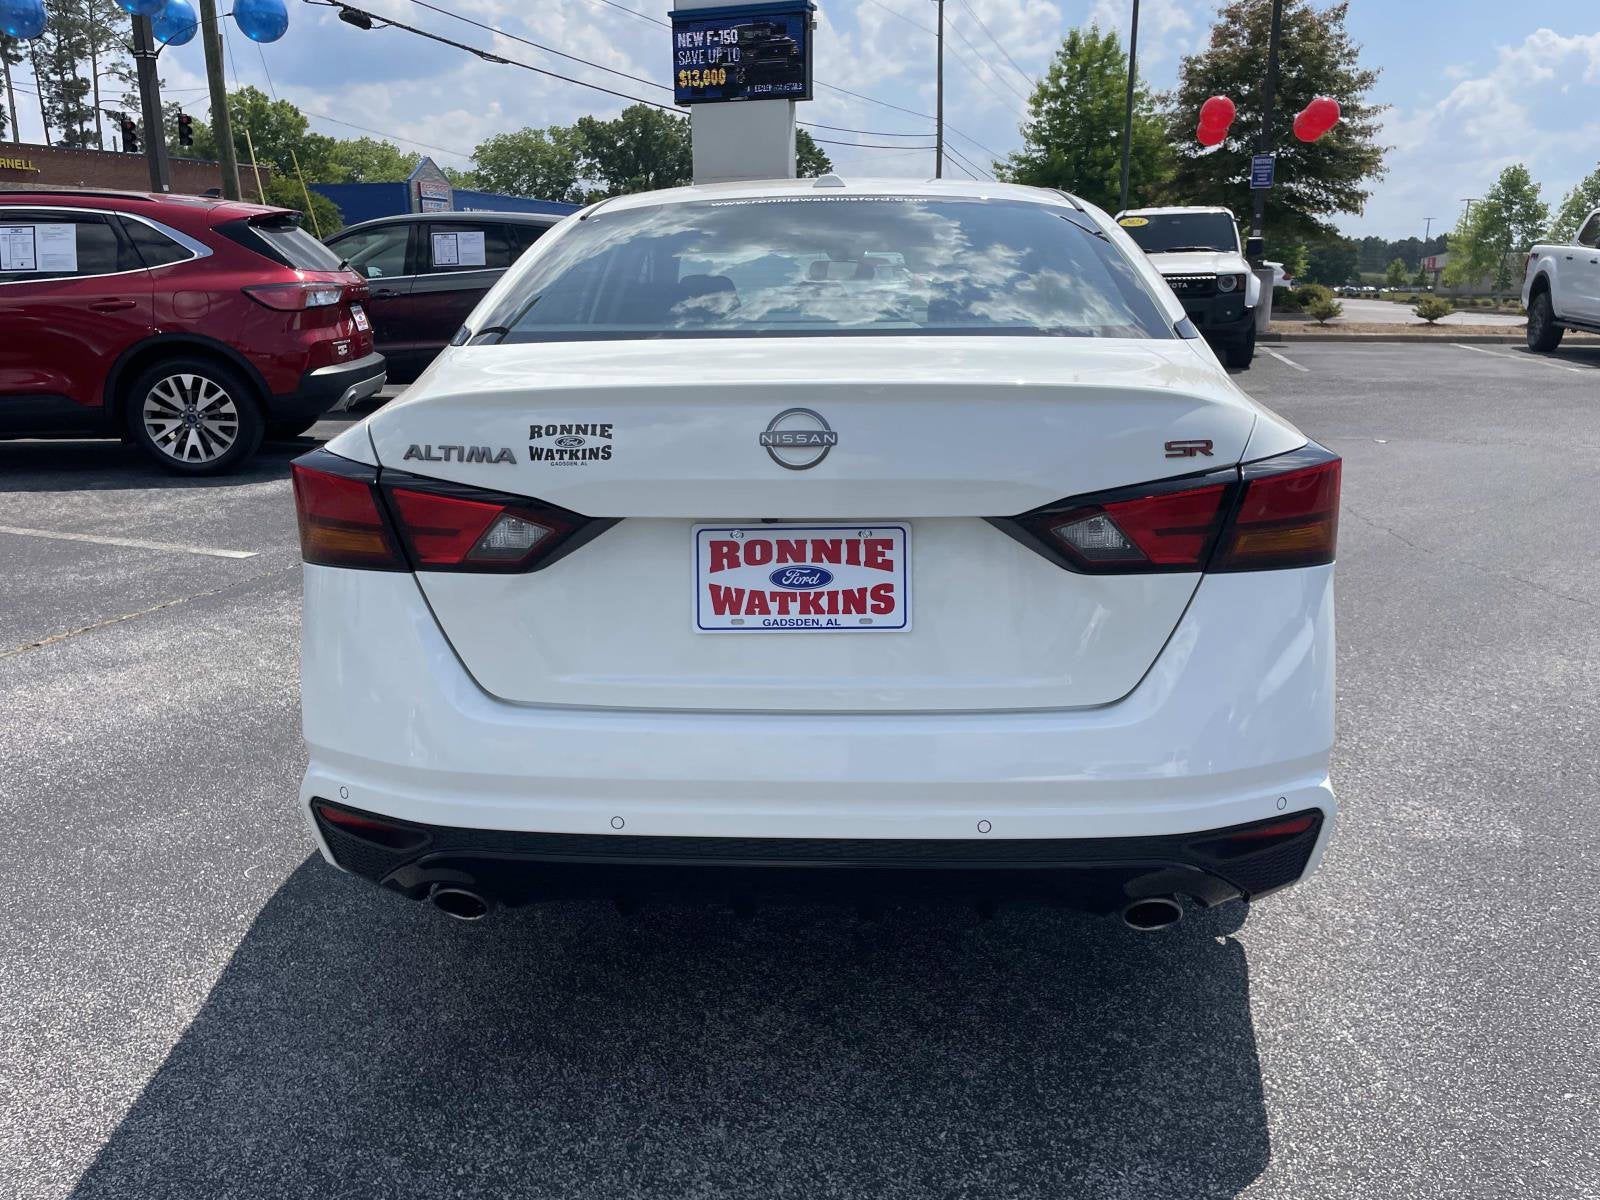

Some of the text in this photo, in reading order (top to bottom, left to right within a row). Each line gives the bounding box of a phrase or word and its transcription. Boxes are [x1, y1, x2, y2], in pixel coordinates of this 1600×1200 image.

[677, 29, 738, 49] NEW F-150
[677, 47, 741, 66] SAVE UP TO
[678, 68, 727, 88] $13,000
[528, 423, 613, 440] RONNIE
[761, 433, 836, 445] NISSAN
[403, 444, 517, 465] ALTIMA
[528, 445, 612, 461] WATKINS
[1164, 440, 1214, 458] SR
[709, 538, 894, 574] RONNIE
[781, 568, 821, 586] Ford
[708, 583, 896, 616] WATKINS
[762, 618, 841, 628] GADSDEN, AL
